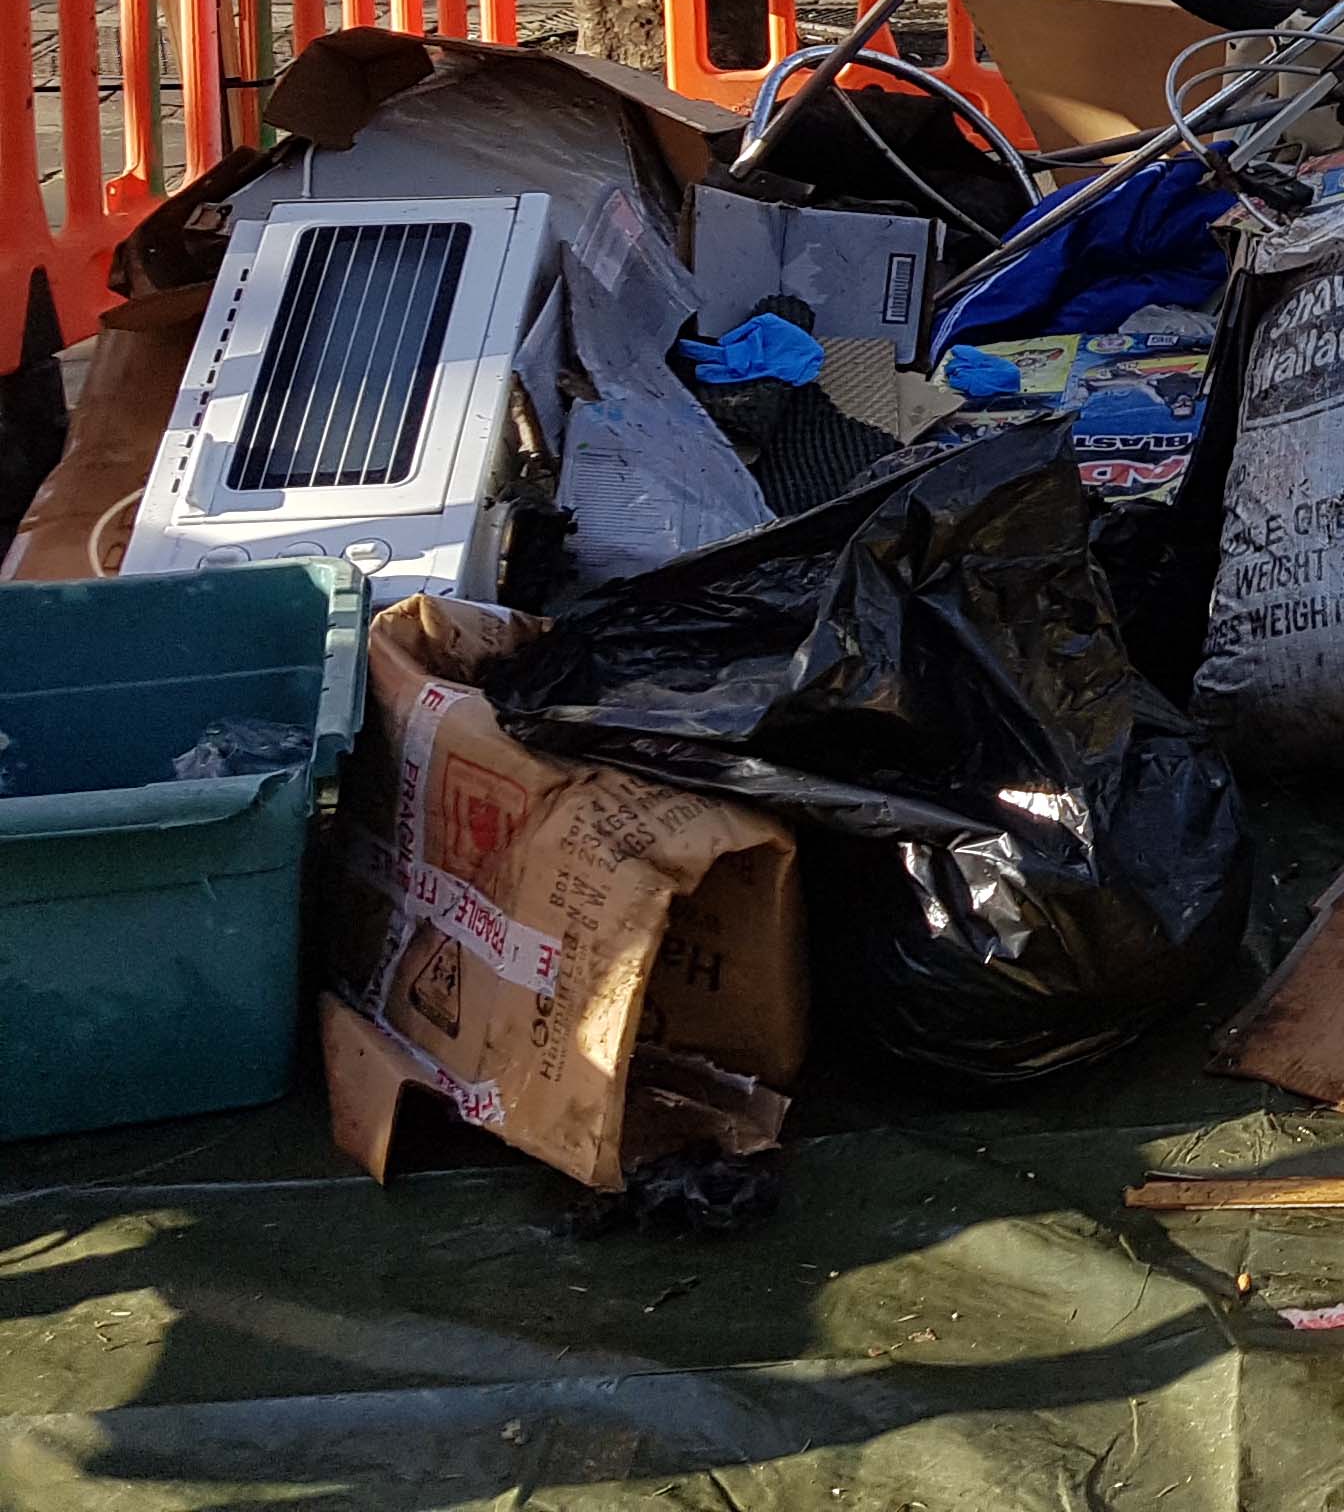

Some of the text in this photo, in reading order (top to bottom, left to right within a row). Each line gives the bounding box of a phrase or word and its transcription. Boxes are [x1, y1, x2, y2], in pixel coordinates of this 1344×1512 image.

[1073, 432, 1192, 451] BLAST
[1235, 547, 1326, 600] WEIGHT
[1249, 592, 1344, 639] WEIGHT
